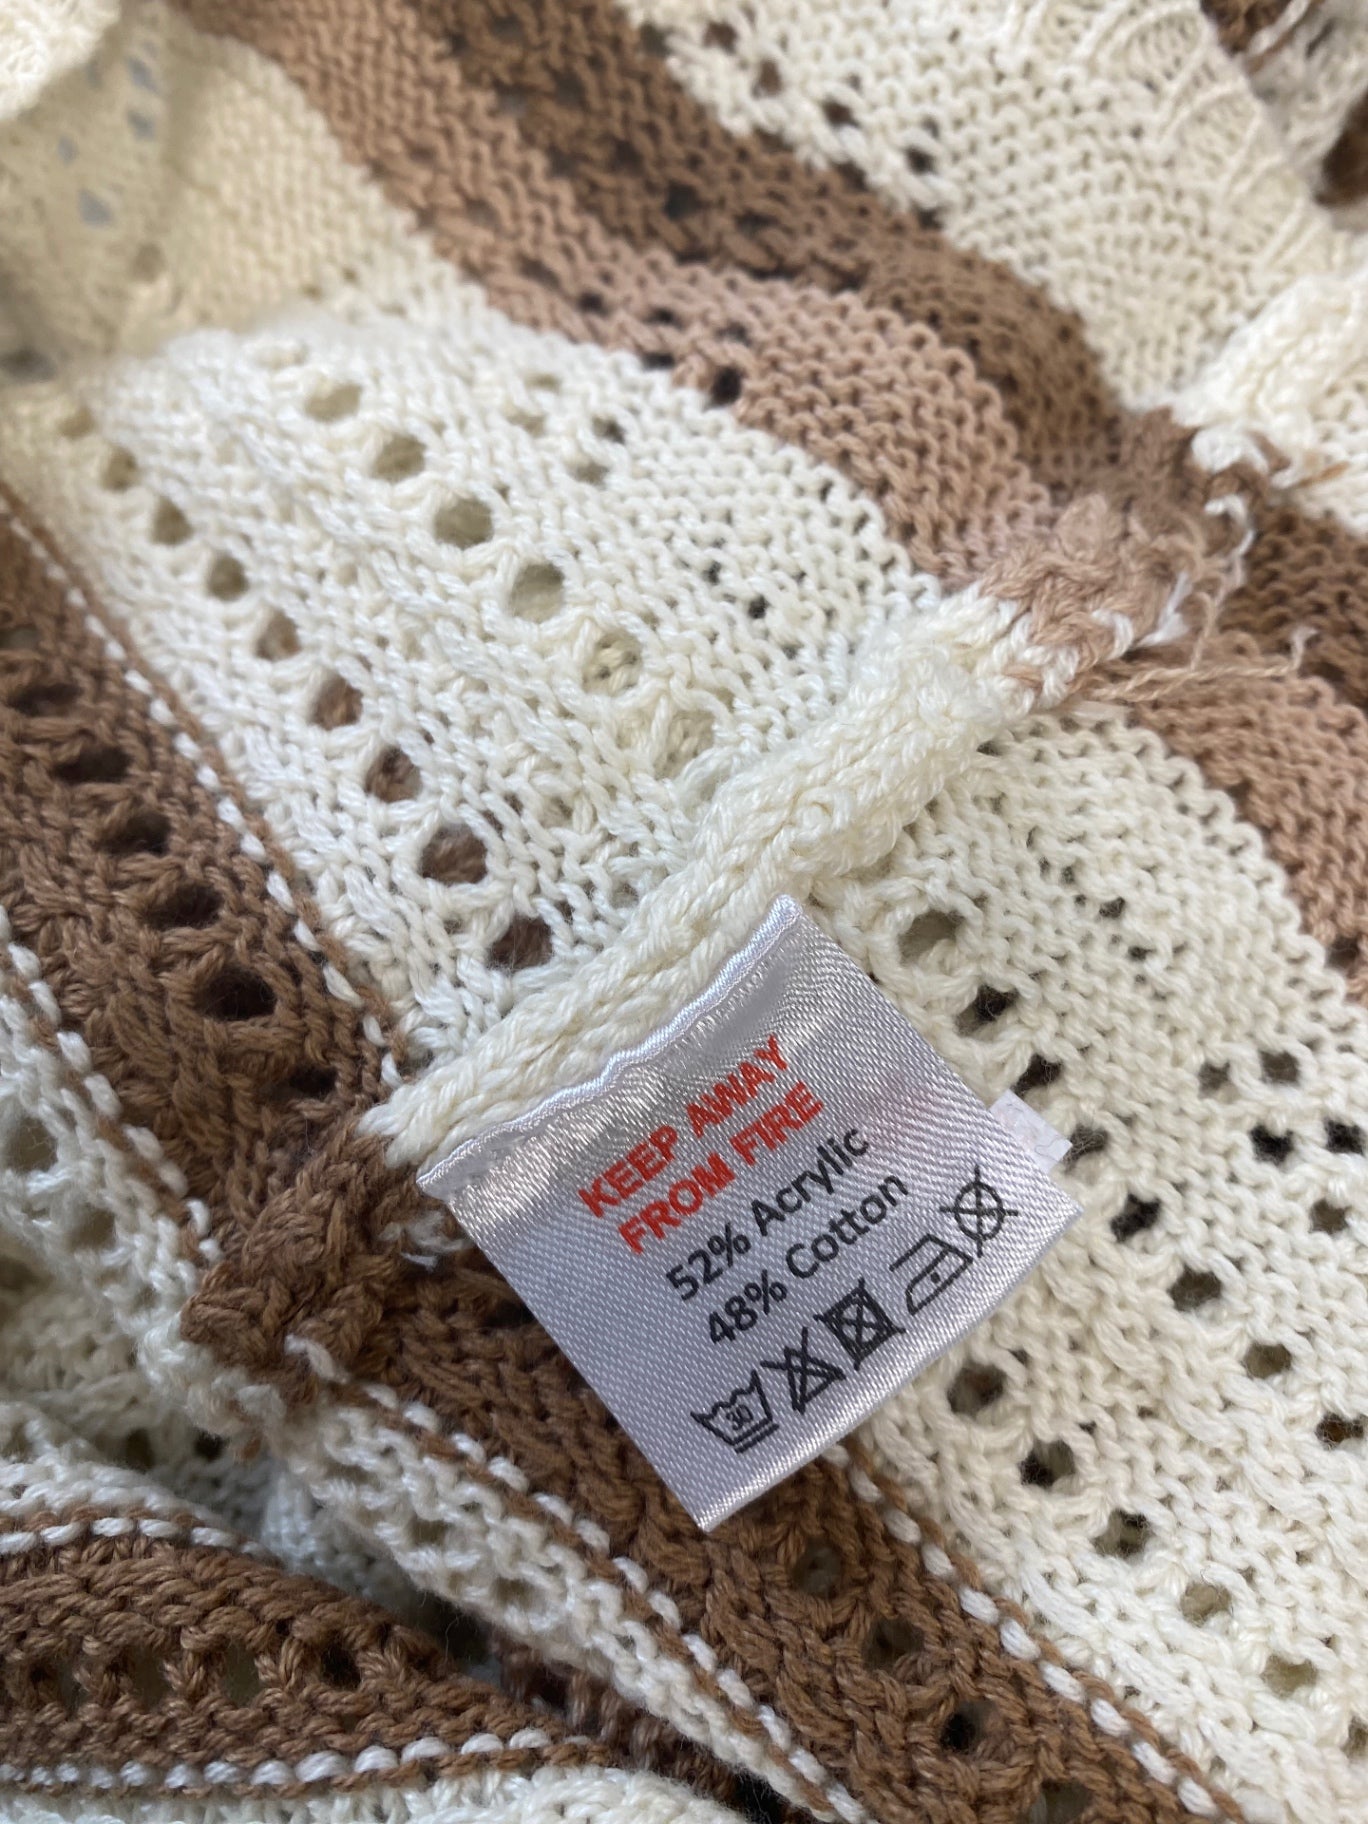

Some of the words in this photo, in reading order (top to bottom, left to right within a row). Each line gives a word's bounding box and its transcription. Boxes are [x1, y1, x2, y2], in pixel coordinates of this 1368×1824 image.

[577, 1125, 679, 1217] KEEP
[686, 1035, 789, 1138] AWAY
[618, 1153, 735, 1254] FROM
[732, 1082, 825, 1165] FIRE
[665, 1225, 750, 1301] 52%
[752, 1128, 870, 1235] Acrylic
[708, 1270, 787, 1344] 48%
[785, 1174, 908, 1280] Cotton
